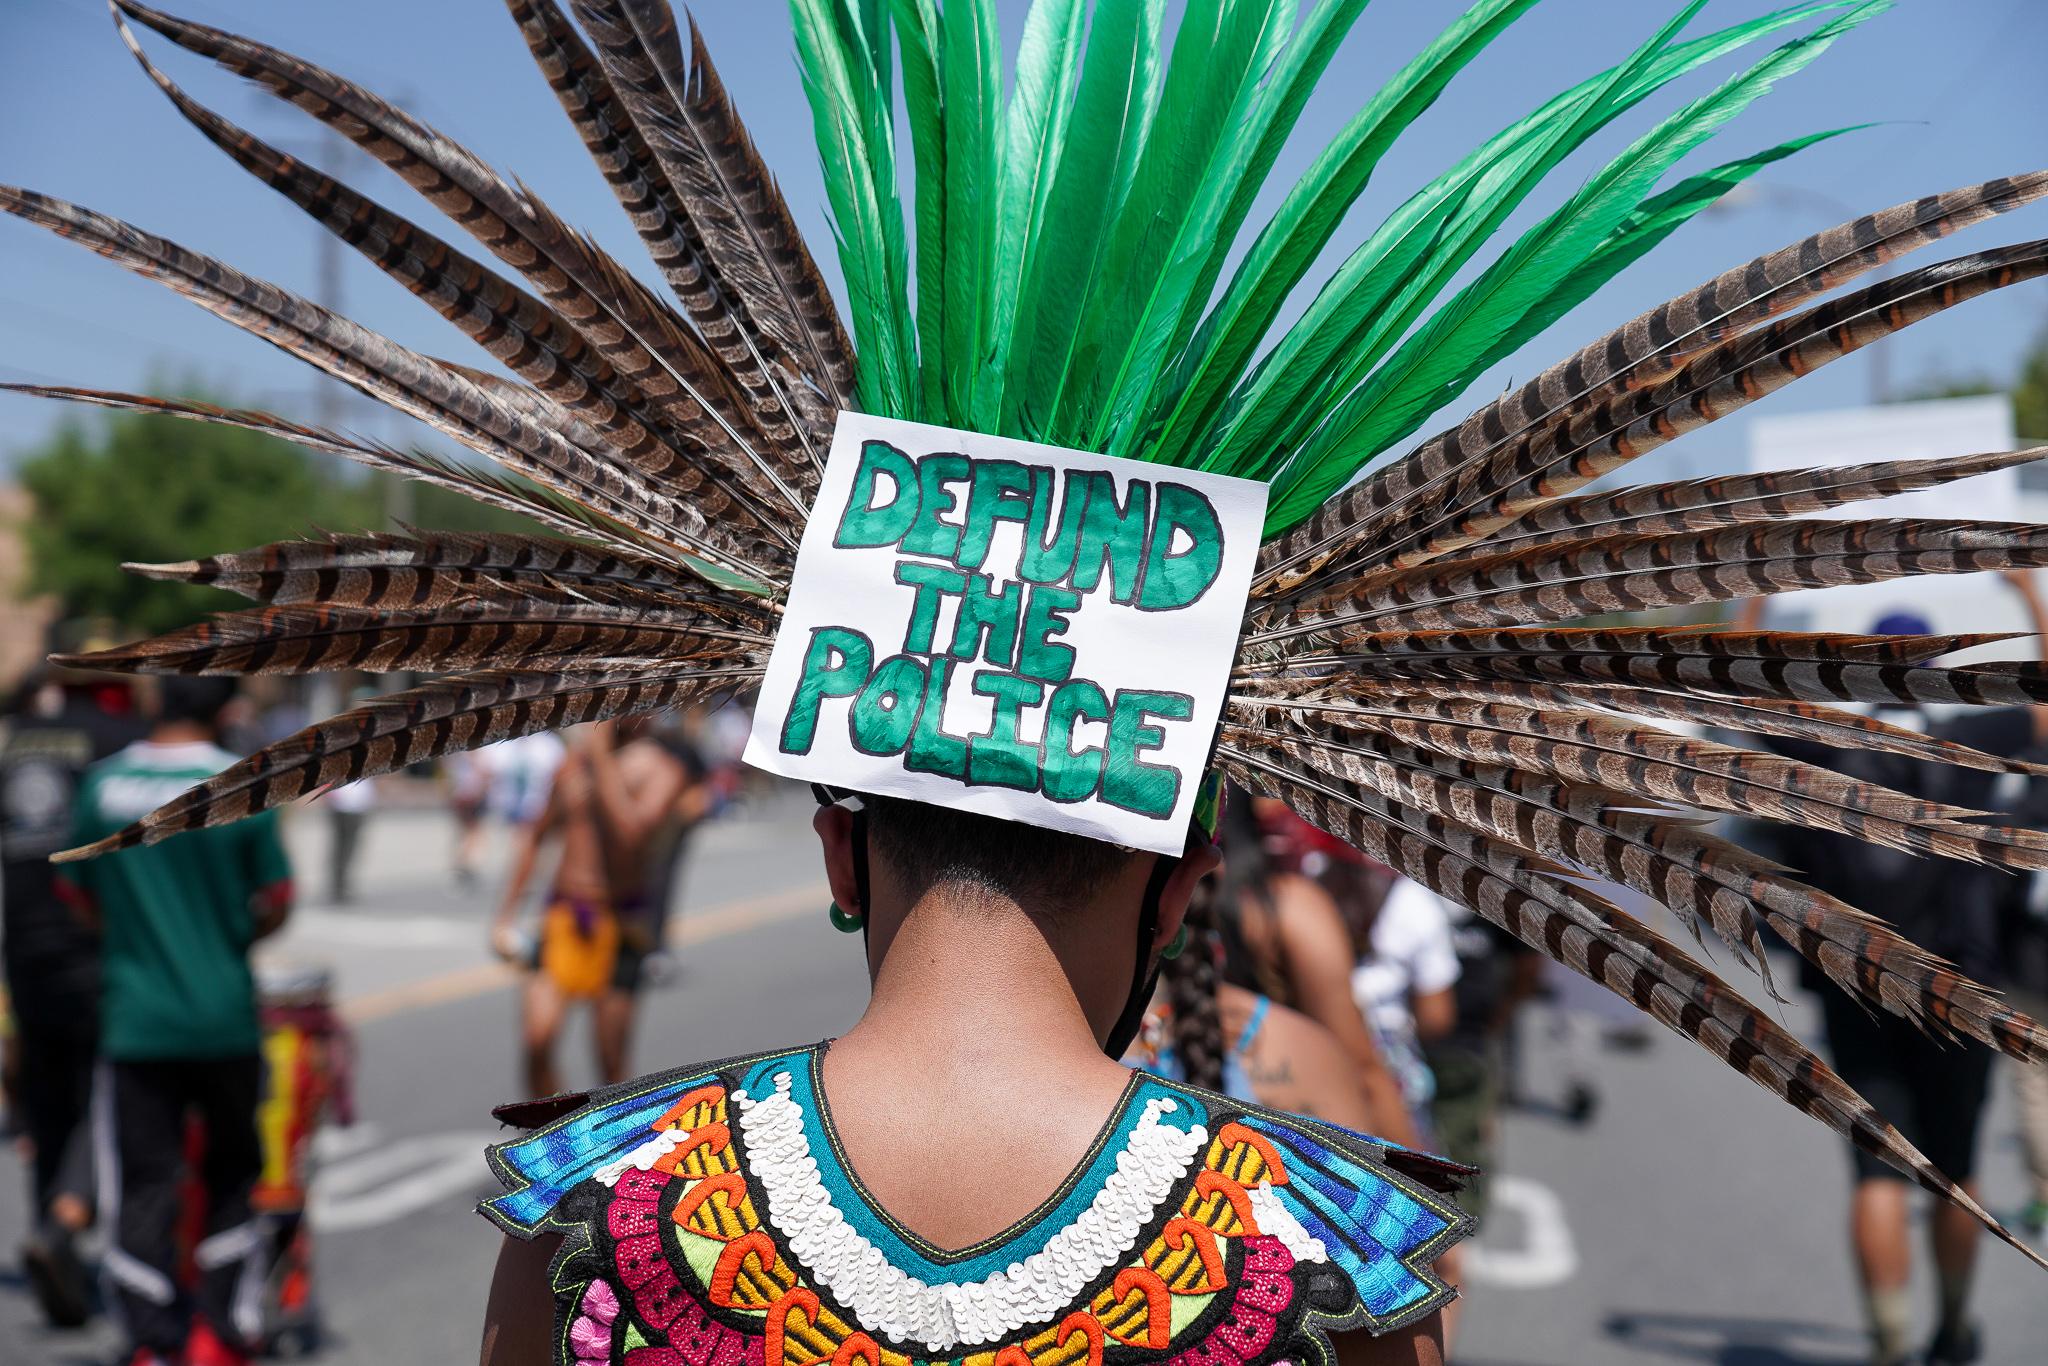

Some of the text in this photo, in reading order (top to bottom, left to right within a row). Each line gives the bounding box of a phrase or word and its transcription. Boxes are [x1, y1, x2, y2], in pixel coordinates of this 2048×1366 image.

[832, 440, 1224, 611] DEFUND
[894, 561, 1082, 684] THE
[779, 626, 1195, 820] POLICE
